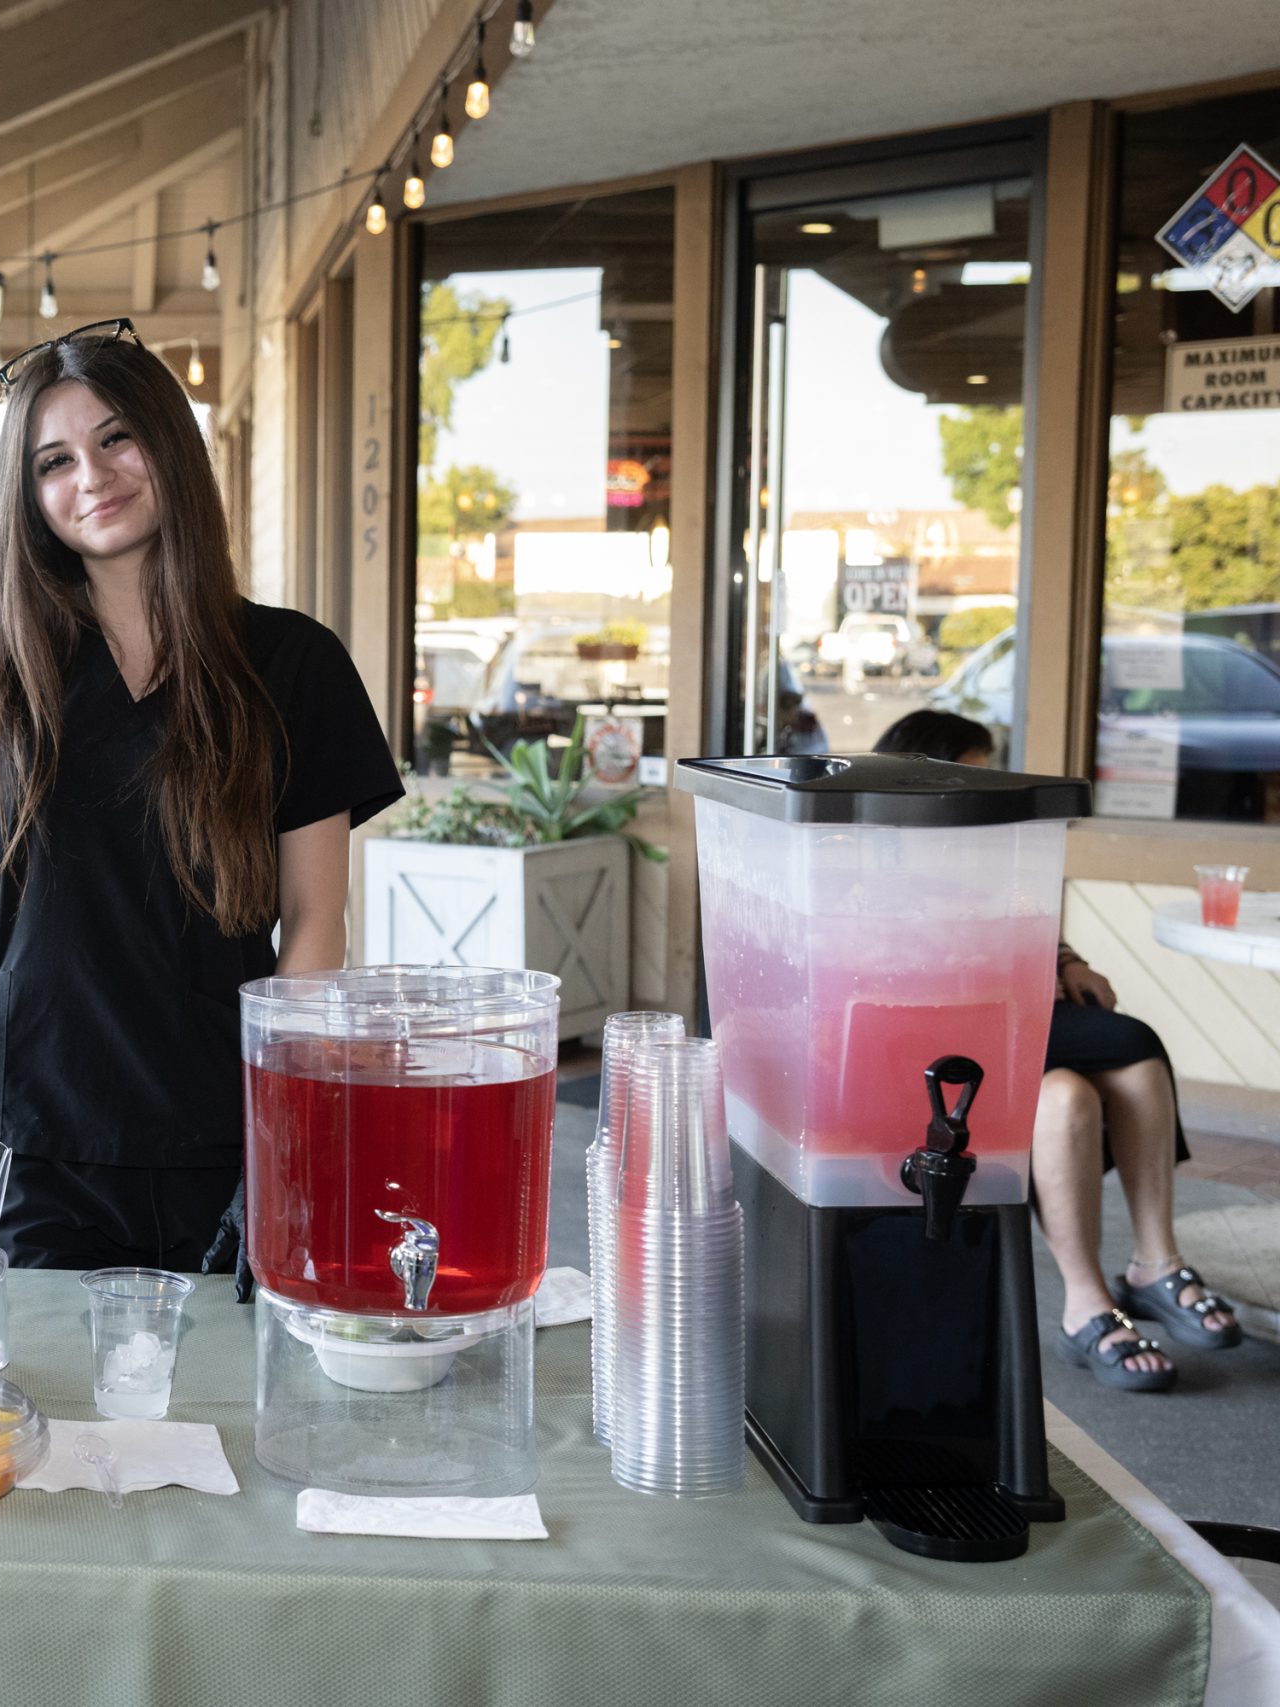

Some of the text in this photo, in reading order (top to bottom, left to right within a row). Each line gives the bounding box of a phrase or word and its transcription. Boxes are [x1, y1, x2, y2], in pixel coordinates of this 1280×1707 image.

[1227, 167, 1256, 211] 0
[1205, 370, 1266, 387] ROOM
[363, 394, 380, 562] 1205
